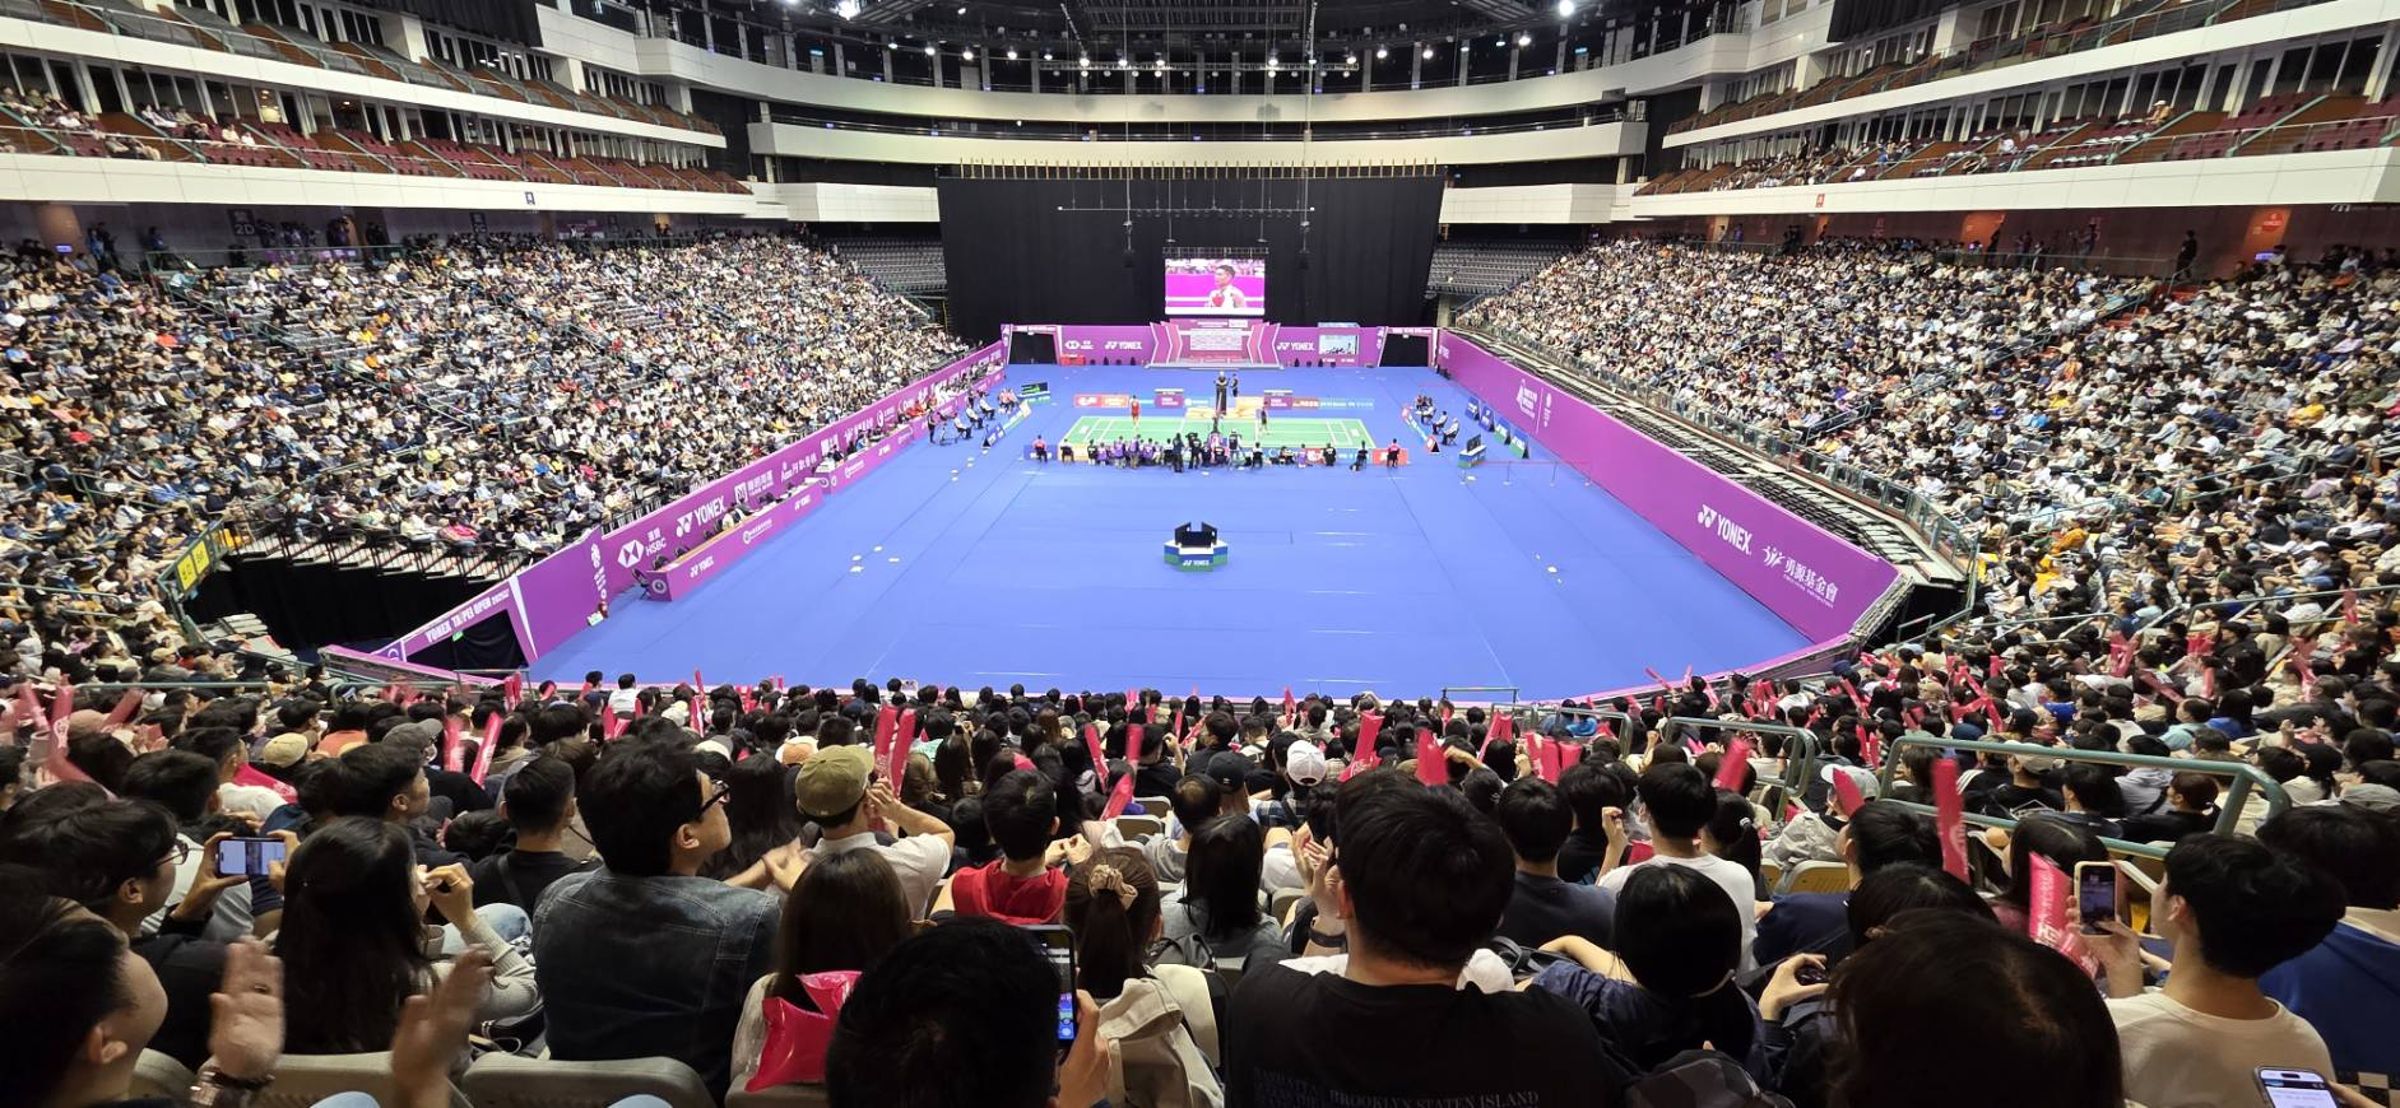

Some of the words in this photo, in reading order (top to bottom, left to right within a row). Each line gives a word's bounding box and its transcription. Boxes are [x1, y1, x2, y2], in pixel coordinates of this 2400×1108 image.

[234, 223, 255, 236] 2D
[1119, 341, 1143, 350] YONEX
[1291, 342, 1315, 351] YONEX
[694, 496, 726, 526] YONEX
[1716, 514, 1753, 555] YONEX
[646, 538, 667, 557] HSBC
[699, 557, 714, 572] YONEX
[425, 621, 452, 643] YONEX
[474, 597, 491, 614] OPEN
[1329, 1089, 1410, 1108] BROOKLYN
[1415, 1097, 1474, 1108] STATEN
[1480, 1089, 1539, 1108] ISLAND
